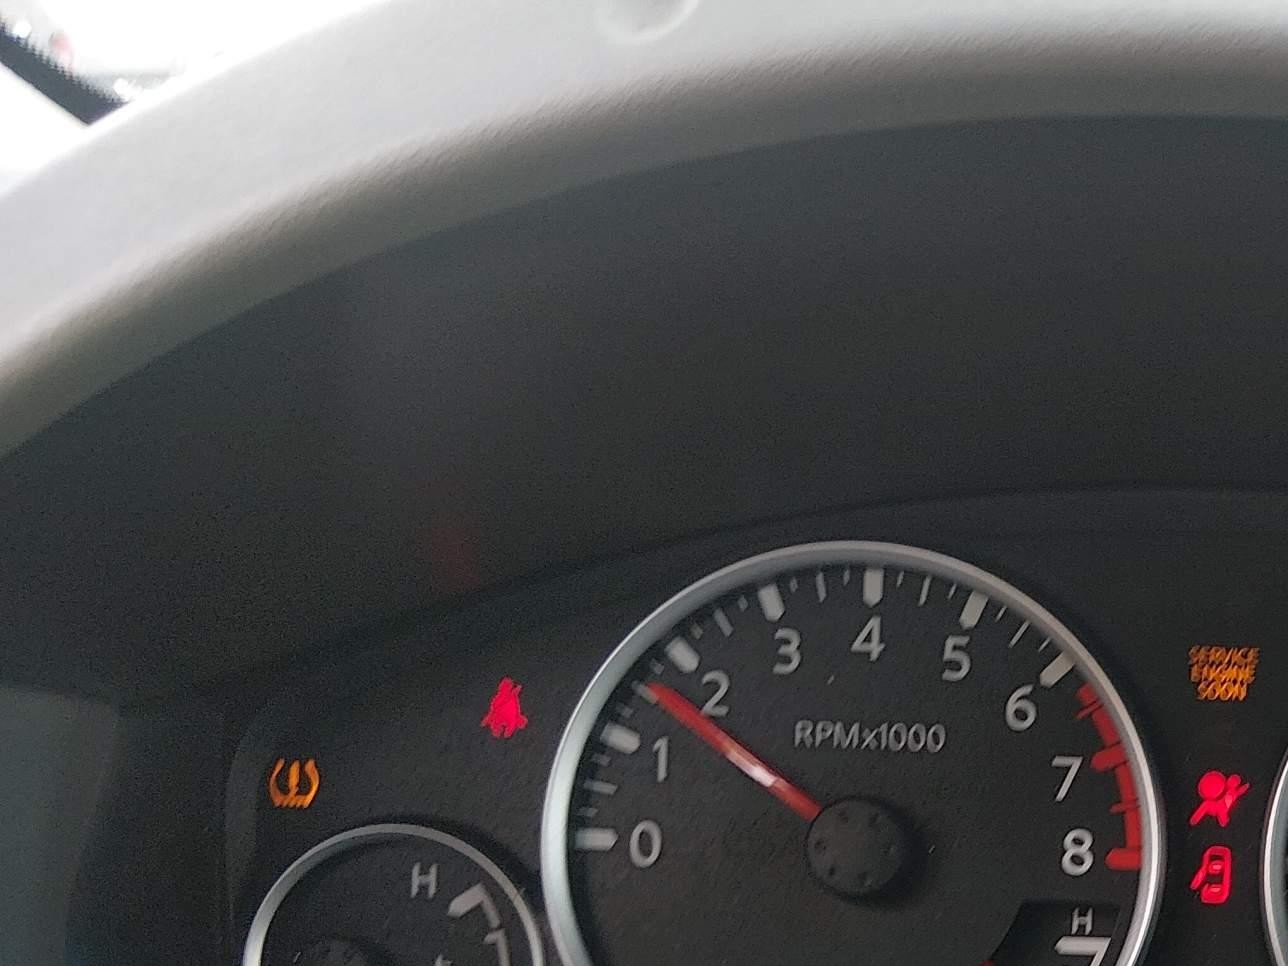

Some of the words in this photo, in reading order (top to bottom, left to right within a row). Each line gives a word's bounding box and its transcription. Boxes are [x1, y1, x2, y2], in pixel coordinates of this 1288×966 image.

[772, 627, 801, 674] 3
[851, 615, 884, 661] 4
[941, 634, 971, 681] 5
[1188, 645, 1261, 664] SERVICE
[701, 671, 730, 716] 2
[1005, 684, 1037, 731] 6
[1197, 681, 1248, 701] SOON
[652, 736, 670, 782] 1
[793, 720, 946, 754] RPMx1000
[1051, 755, 1083, 801] 7
[629, 819, 662, 868] 0
[1061, 827, 1095, 876] 8
[410, 863, 438, 898] H
[1071, 906, 1094, 935] H
